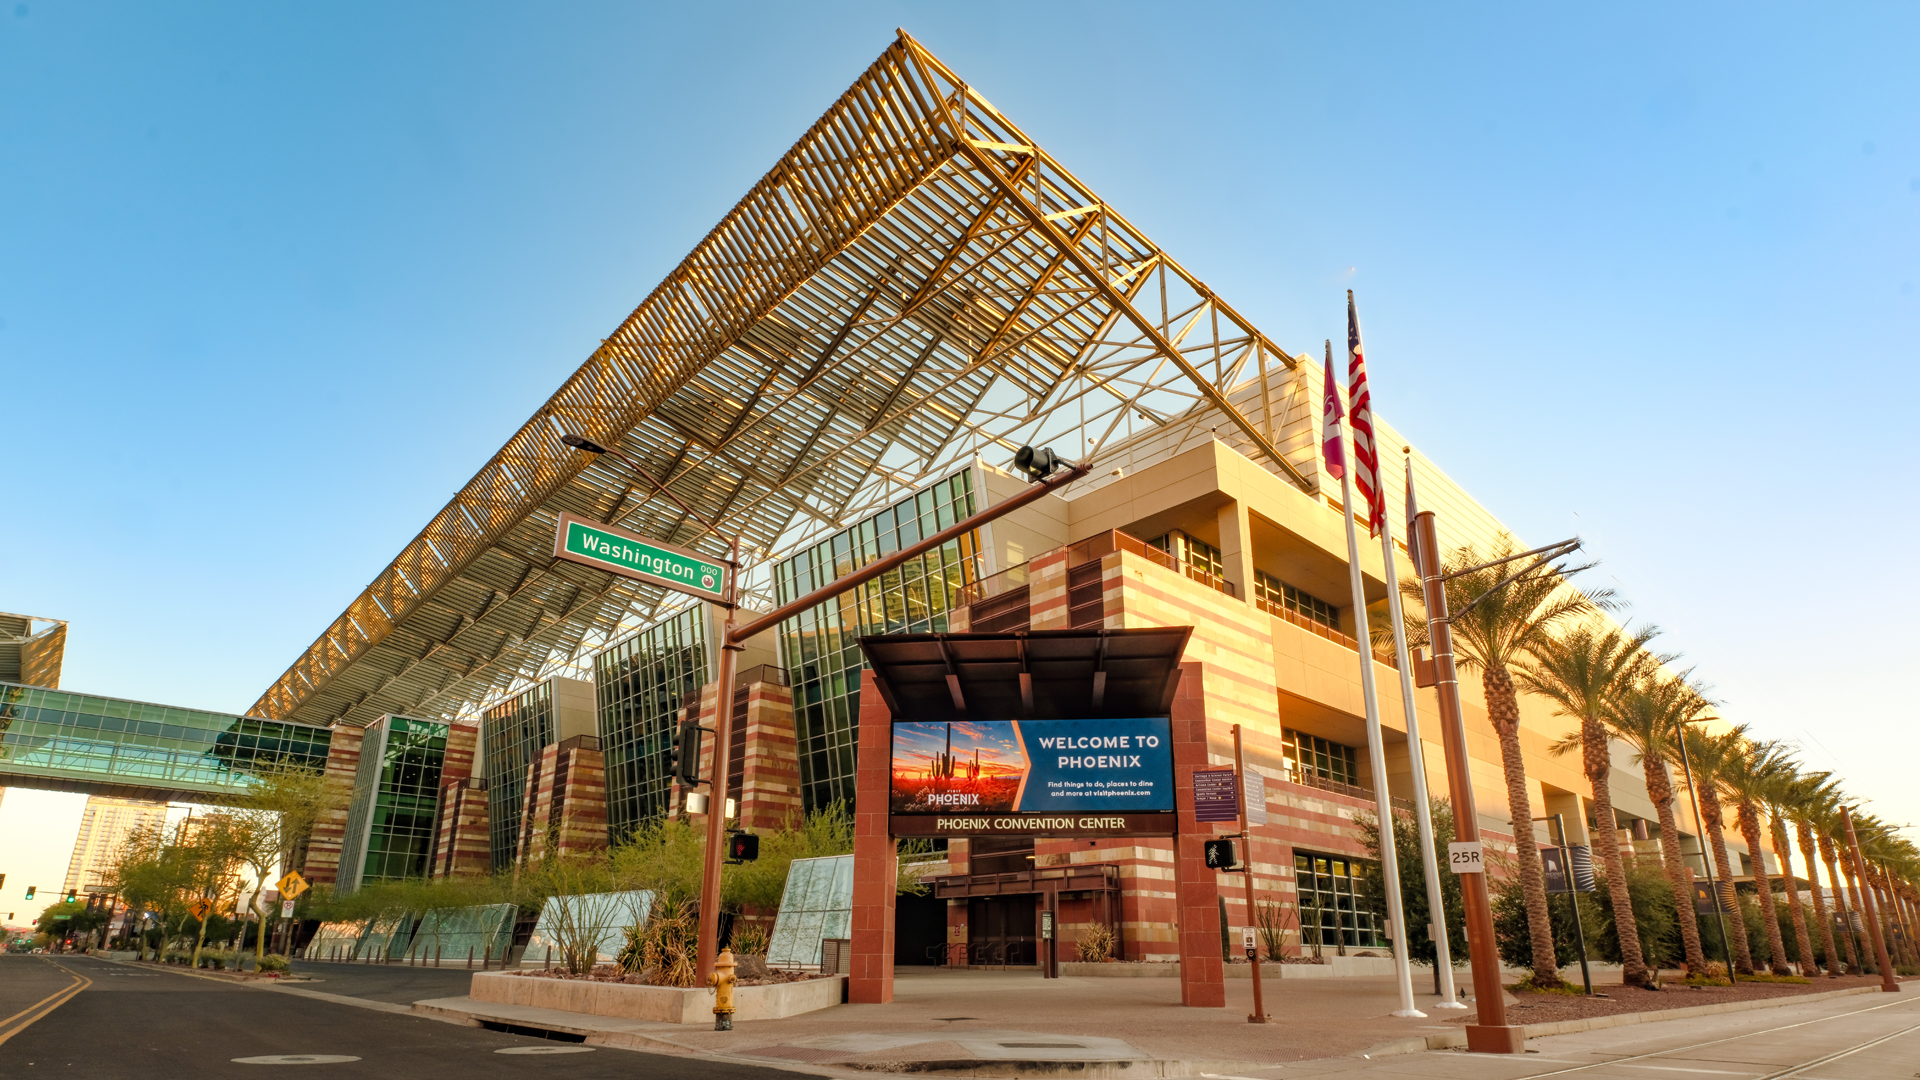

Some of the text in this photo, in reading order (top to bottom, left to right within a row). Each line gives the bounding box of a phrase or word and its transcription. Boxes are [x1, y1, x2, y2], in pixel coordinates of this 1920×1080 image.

[583, 533, 694, 580] Washington
[1039, 735, 1159, 749] WELCOME TO
[1058, 755, 1141, 768] PHOENIX
[1064, 781, 1084, 789] things
[928, 794, 980, 805] PHOENIX
[1093, 790, 1151, 798] visitphoenix.com
[937, 818, 1126, 830] PHOENIX CONVENTION CENTER
[1452, 851, 1480, 864] 25R
